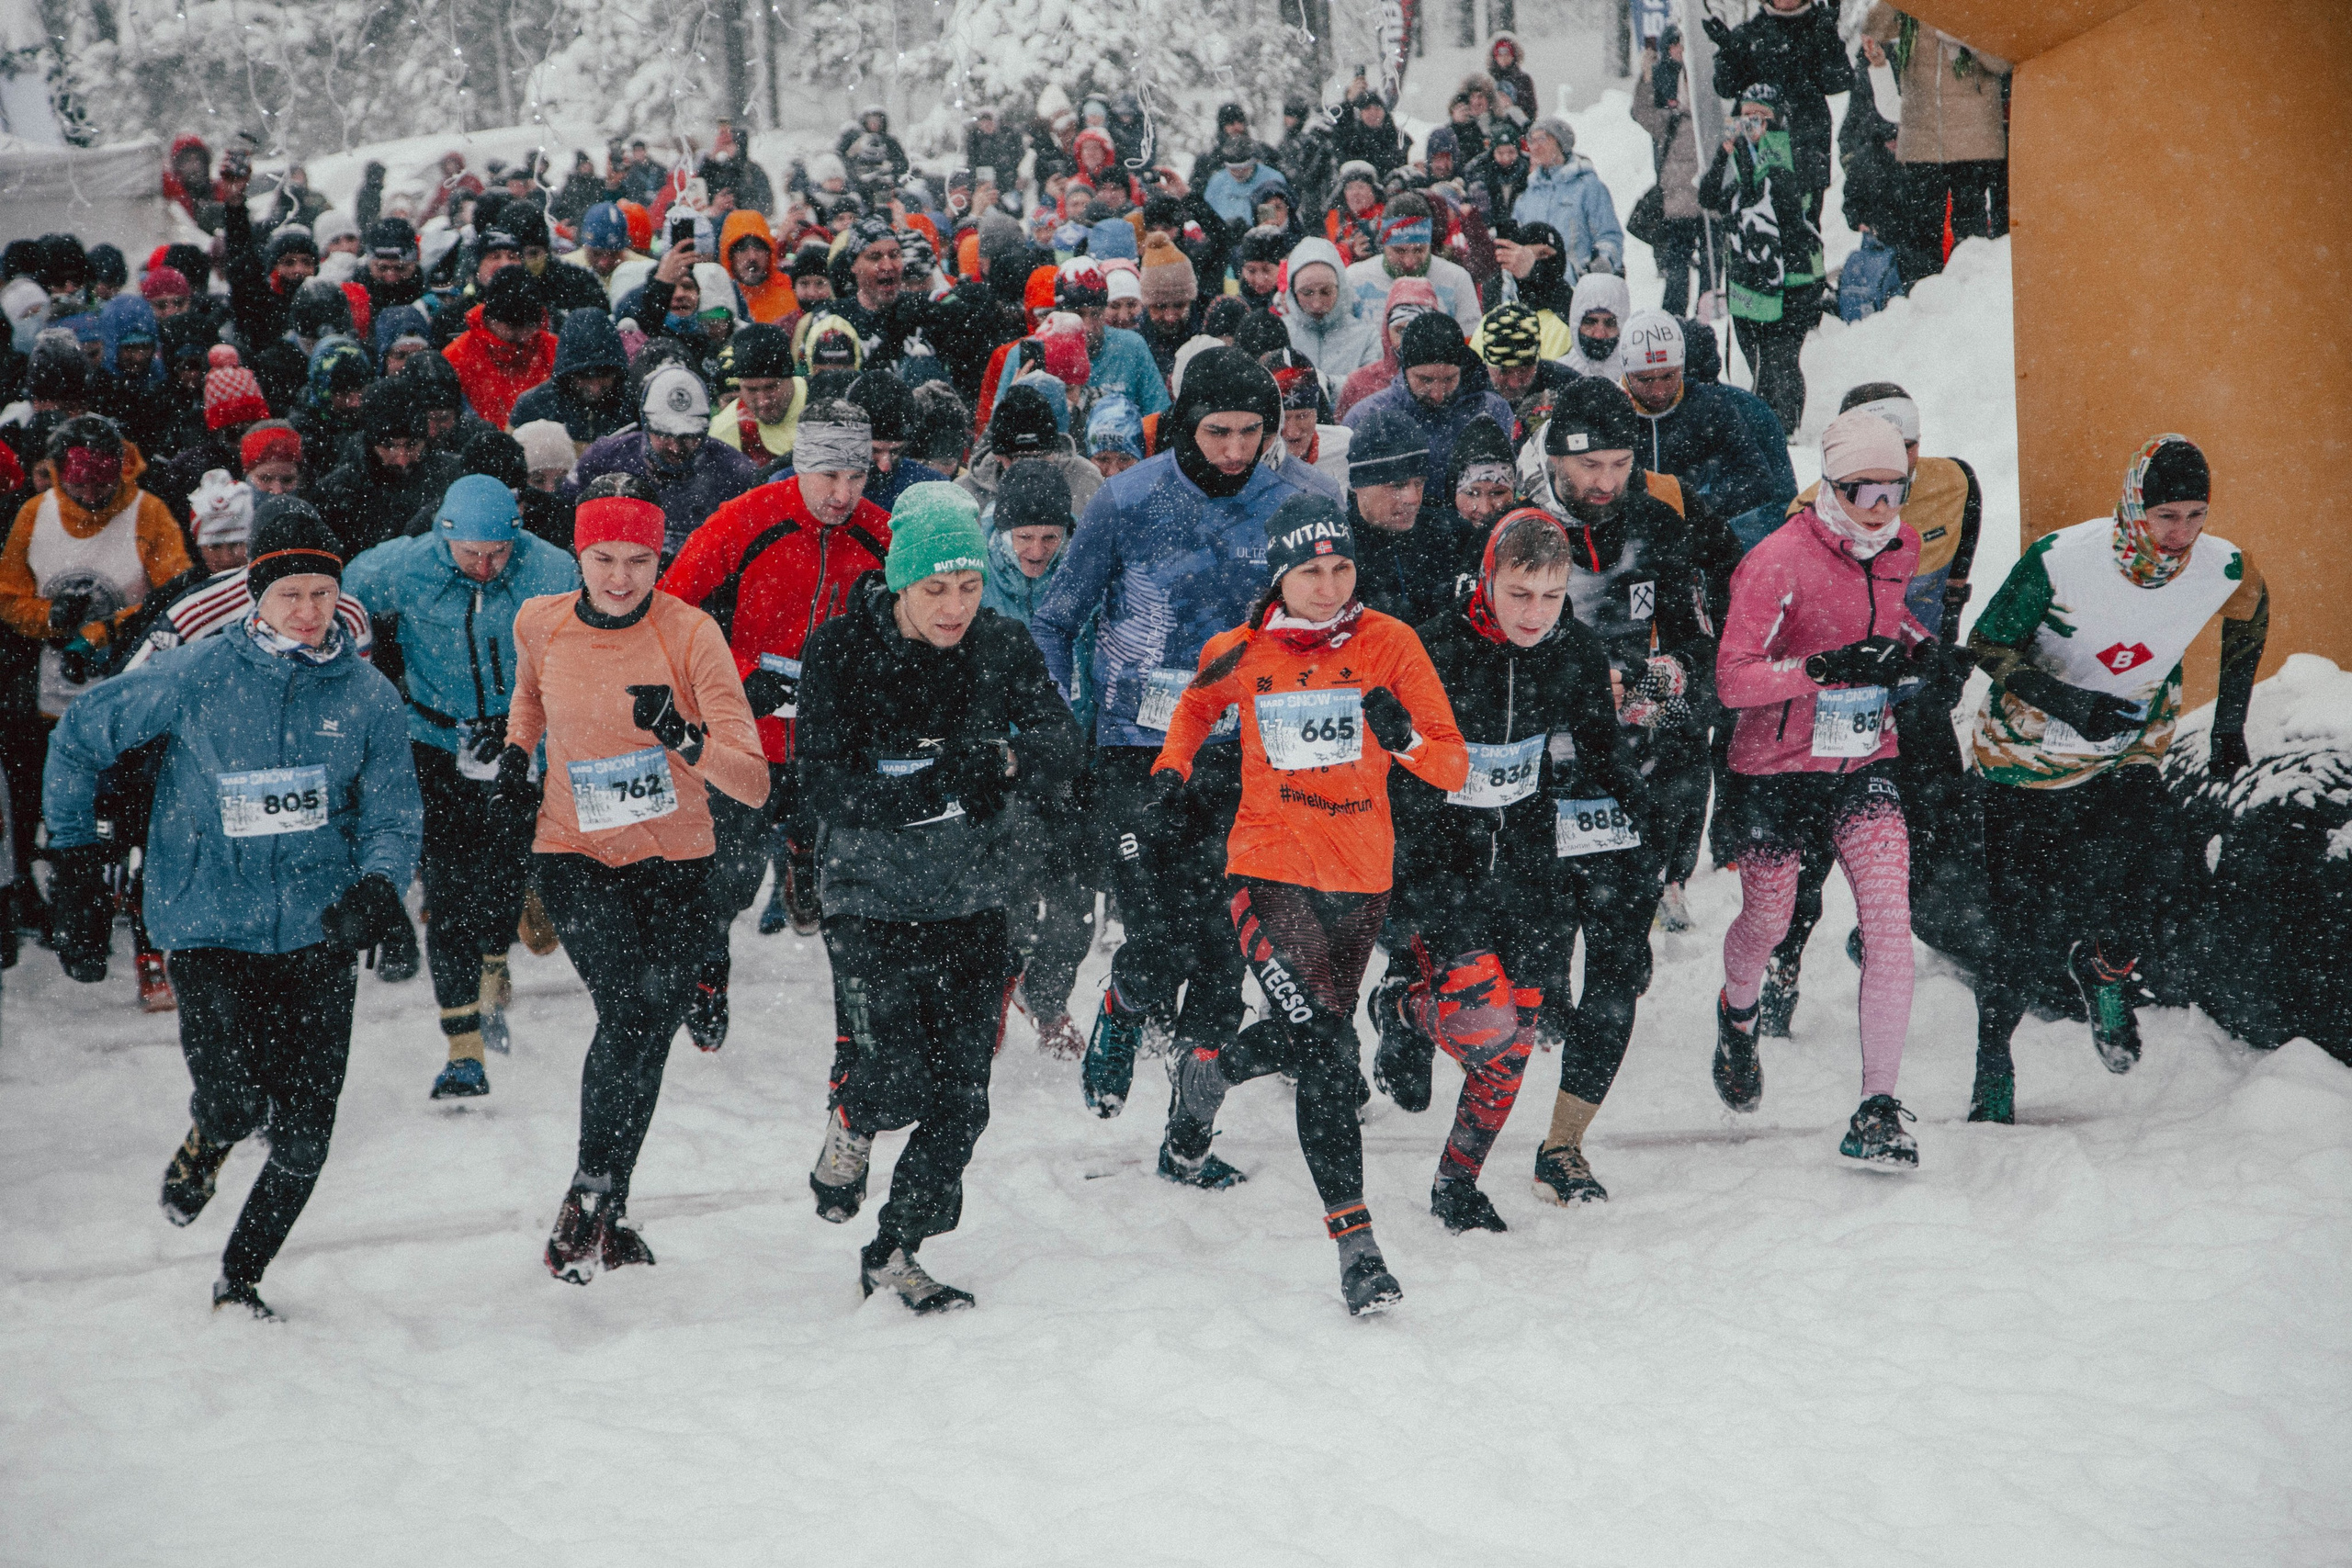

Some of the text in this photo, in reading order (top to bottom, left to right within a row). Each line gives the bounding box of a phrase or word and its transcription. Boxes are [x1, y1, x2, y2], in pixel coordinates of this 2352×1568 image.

[1632, 324, 1674, 353] DNB
[2111, 650, 2135, 669] B
[1260, 698, 1284, 708] HARD
[1287, 693, 1331, 708] SNOW
[1846, 688, 1878, 704] SNOW
[1819, 711, 1840, 722] T-7
[1261, 716, 1355, 743] T-7 665
[1480, 744, 1521, 759] SNOW
[594, 755, 636, 774] SNOW
[1489, 763, 1532, 787] 836
[249, 770, 294, 785] SNOW
[612, 773, 663, 802] 762
[264, 788, 319, 815] 805
[1577, 807, 1626, 832] 888
[1260, 957, 1314, 1024] TECSO
